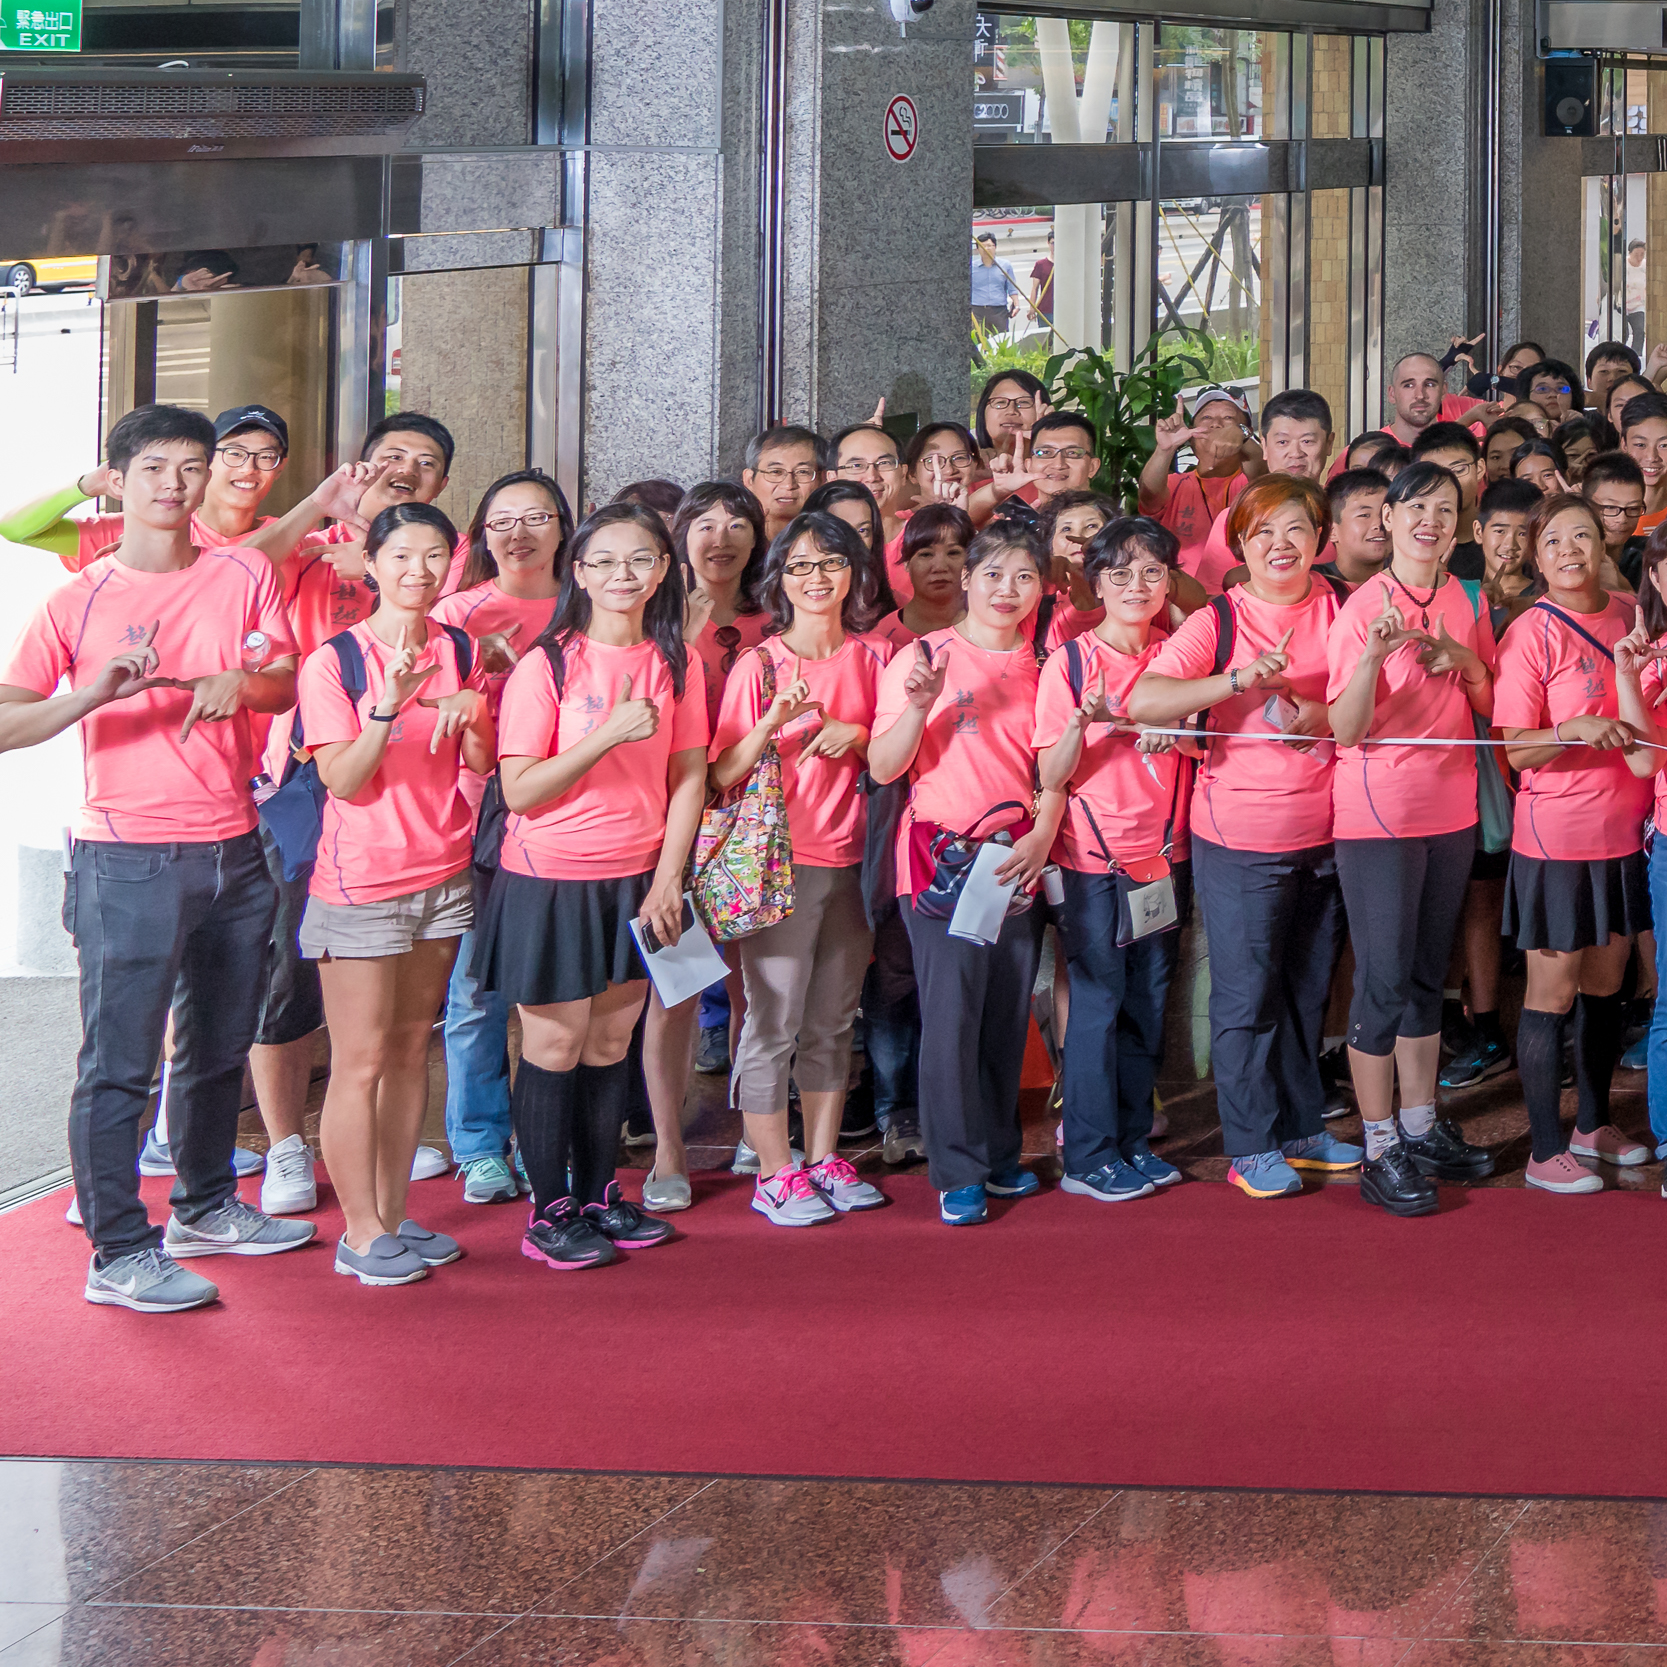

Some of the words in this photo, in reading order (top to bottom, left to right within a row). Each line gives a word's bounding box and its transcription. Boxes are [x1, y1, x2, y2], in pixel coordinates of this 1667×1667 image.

[16, 9, 73, 30] 緊急出口
[19, 33, 71, 46] EXIT
[330, 583, 361, 626] 超越
[1576, 656, 1607, 698] 超越
[949, 688, 980, 734] 超越
